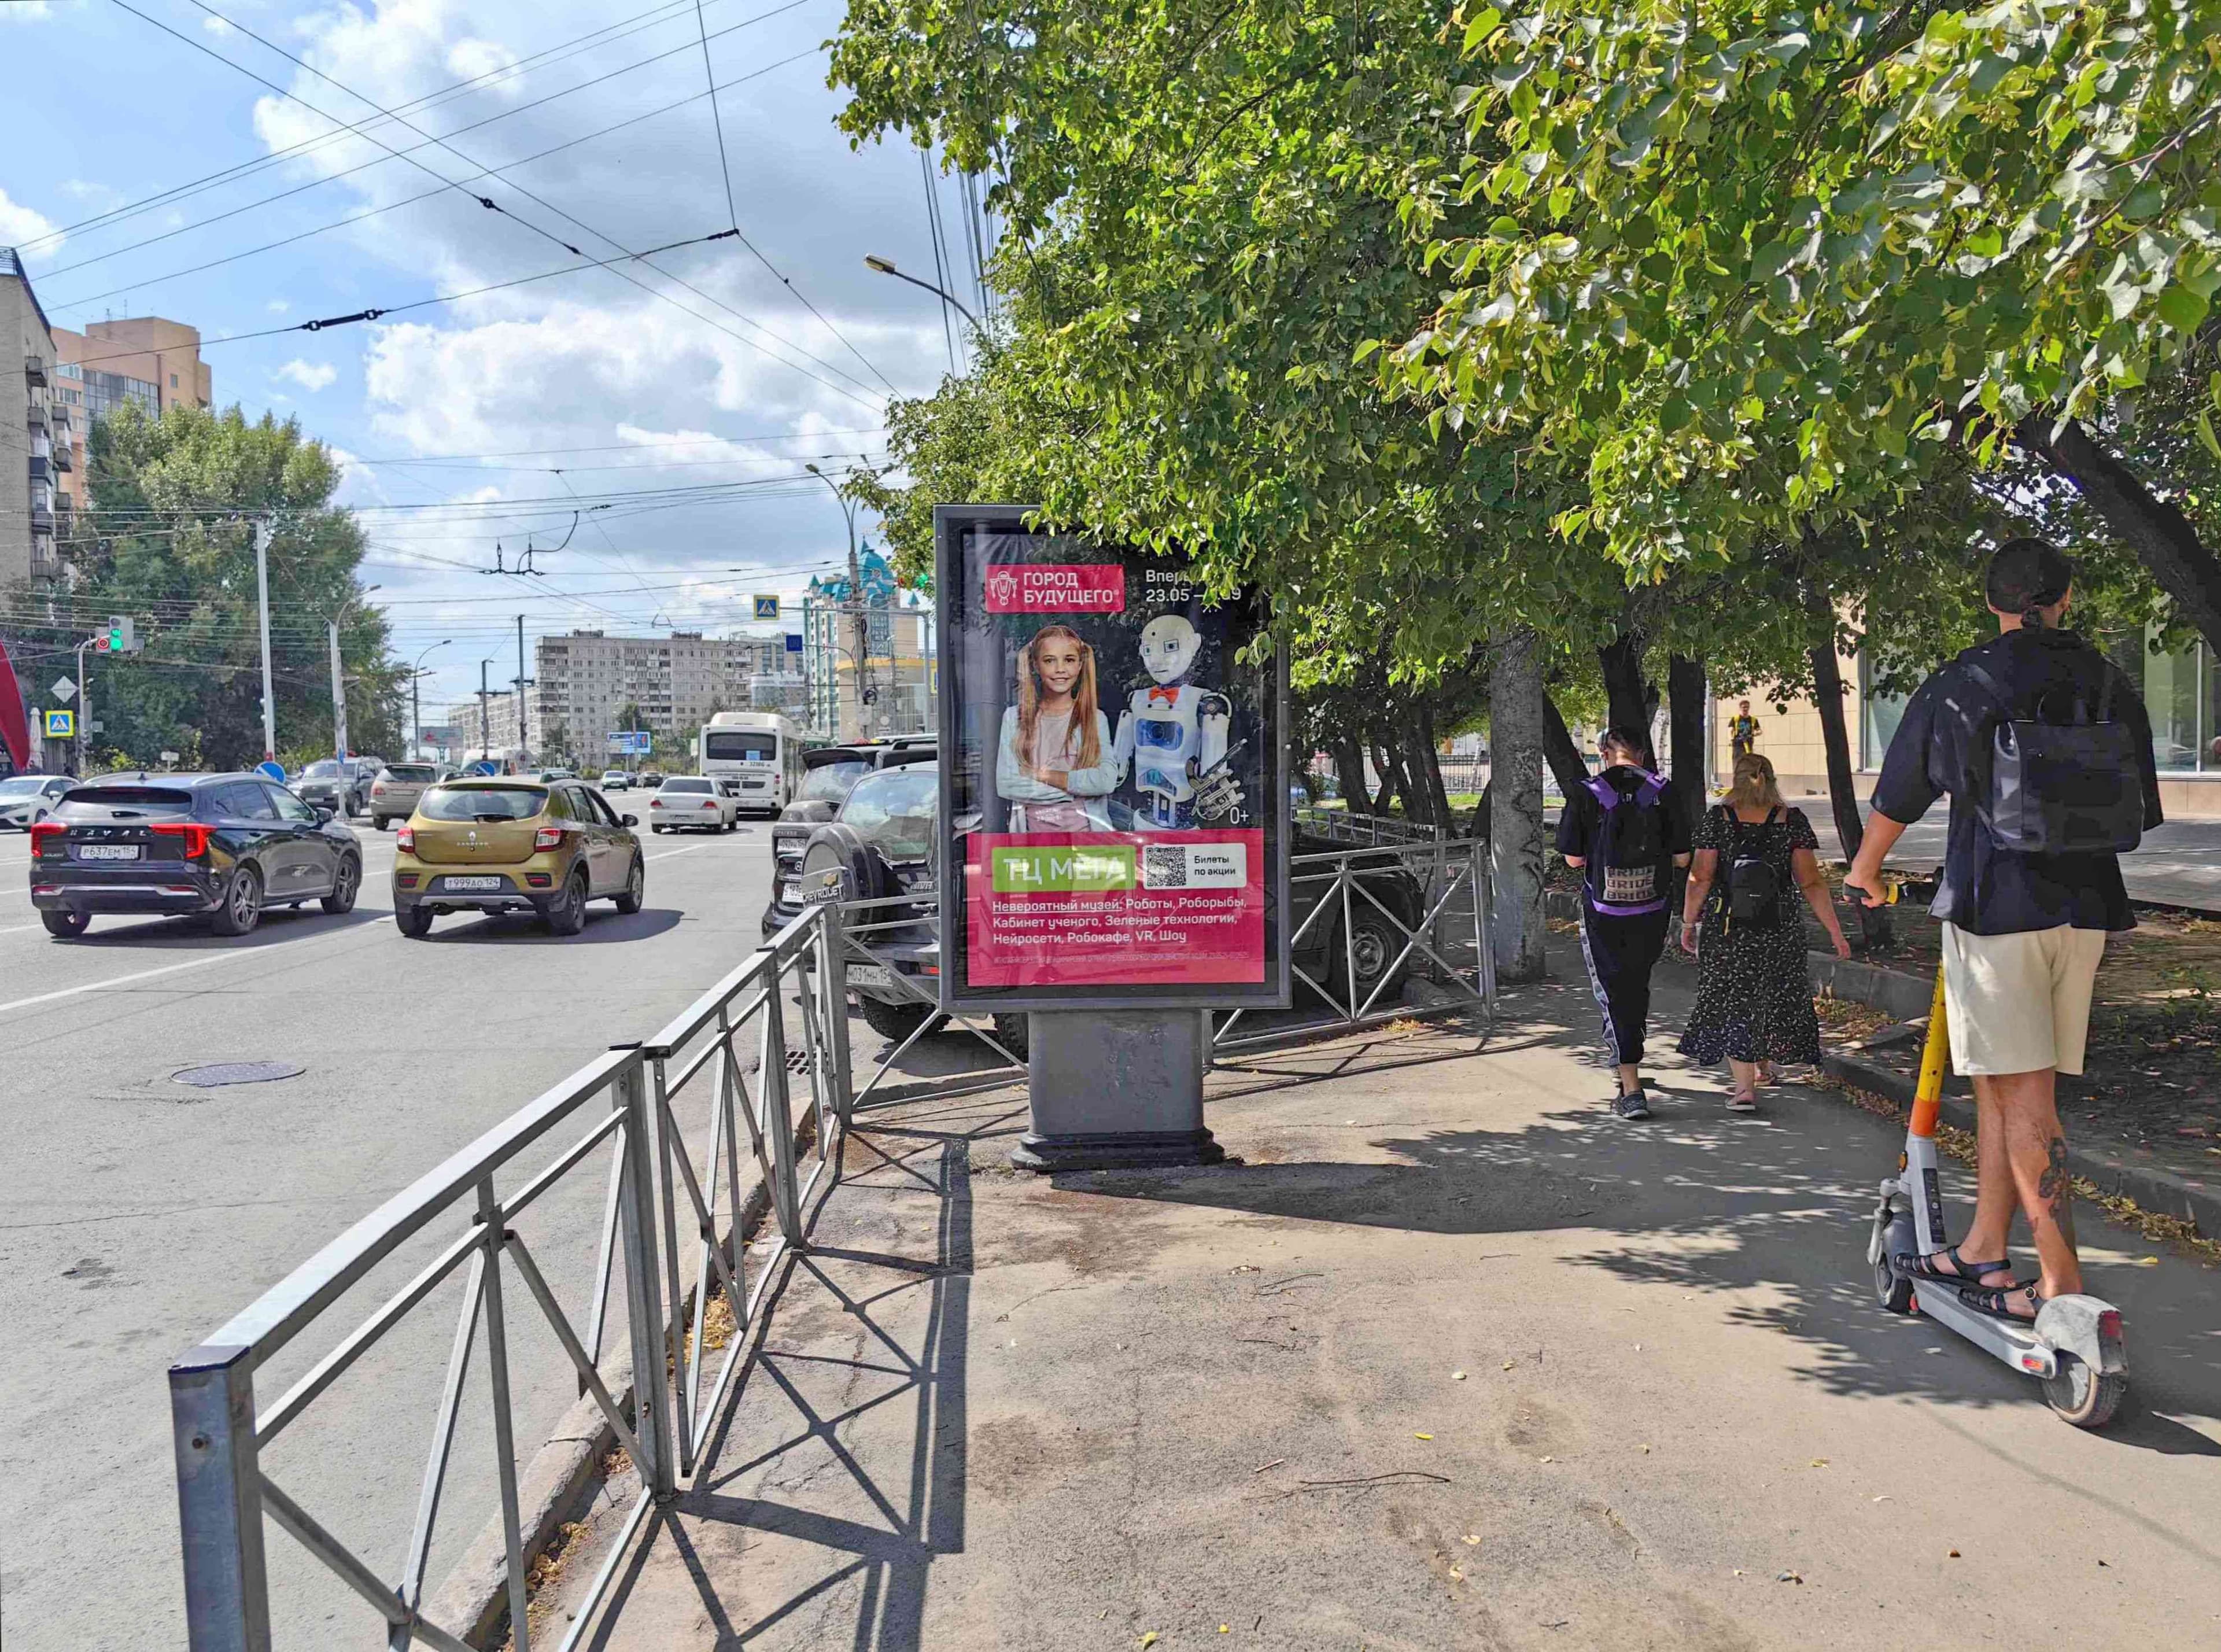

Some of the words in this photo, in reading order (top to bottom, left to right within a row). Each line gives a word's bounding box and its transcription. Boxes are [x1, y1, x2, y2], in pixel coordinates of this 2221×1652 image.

[1024, 572, 1078, 588] ГОРОД
[1024, 589, 1113, 606] БУДУЩЕГО
[1146, 588, 1189, 602] 23.05
[1230, 806, 1249, 824] 0+
[1194, 856, 1229, 864] Билеты
[1003, 858, 1042, 885] ТЦ
[1050, 857, 1126, 880] МЕГА
[1208, 868, 1236, 876] акции
[1607, 876, 1654, 889] BRIDE
[992, 899, 1078, 913] Невероятный
[1080, 898, 1123, 912] музей:
[1126, 897, 1175, 910] Роботы,
[1179, 896, 1247, 910] Роборыбы,
[993, 917, 1045, 928] Кабинет
[1048, 917, 1102, 930] ученого,
[1105, 915, 1160, 927] Зеленые
[1164, 915, 1238, 925] технологии,
[993, 932, 1065, 946] Нейросети,
[1067, 930, 1133, 945] Робокафе,
[1135, 930, 1156, 943] VR,
[1159, 929, 1187, 943] Шоу
